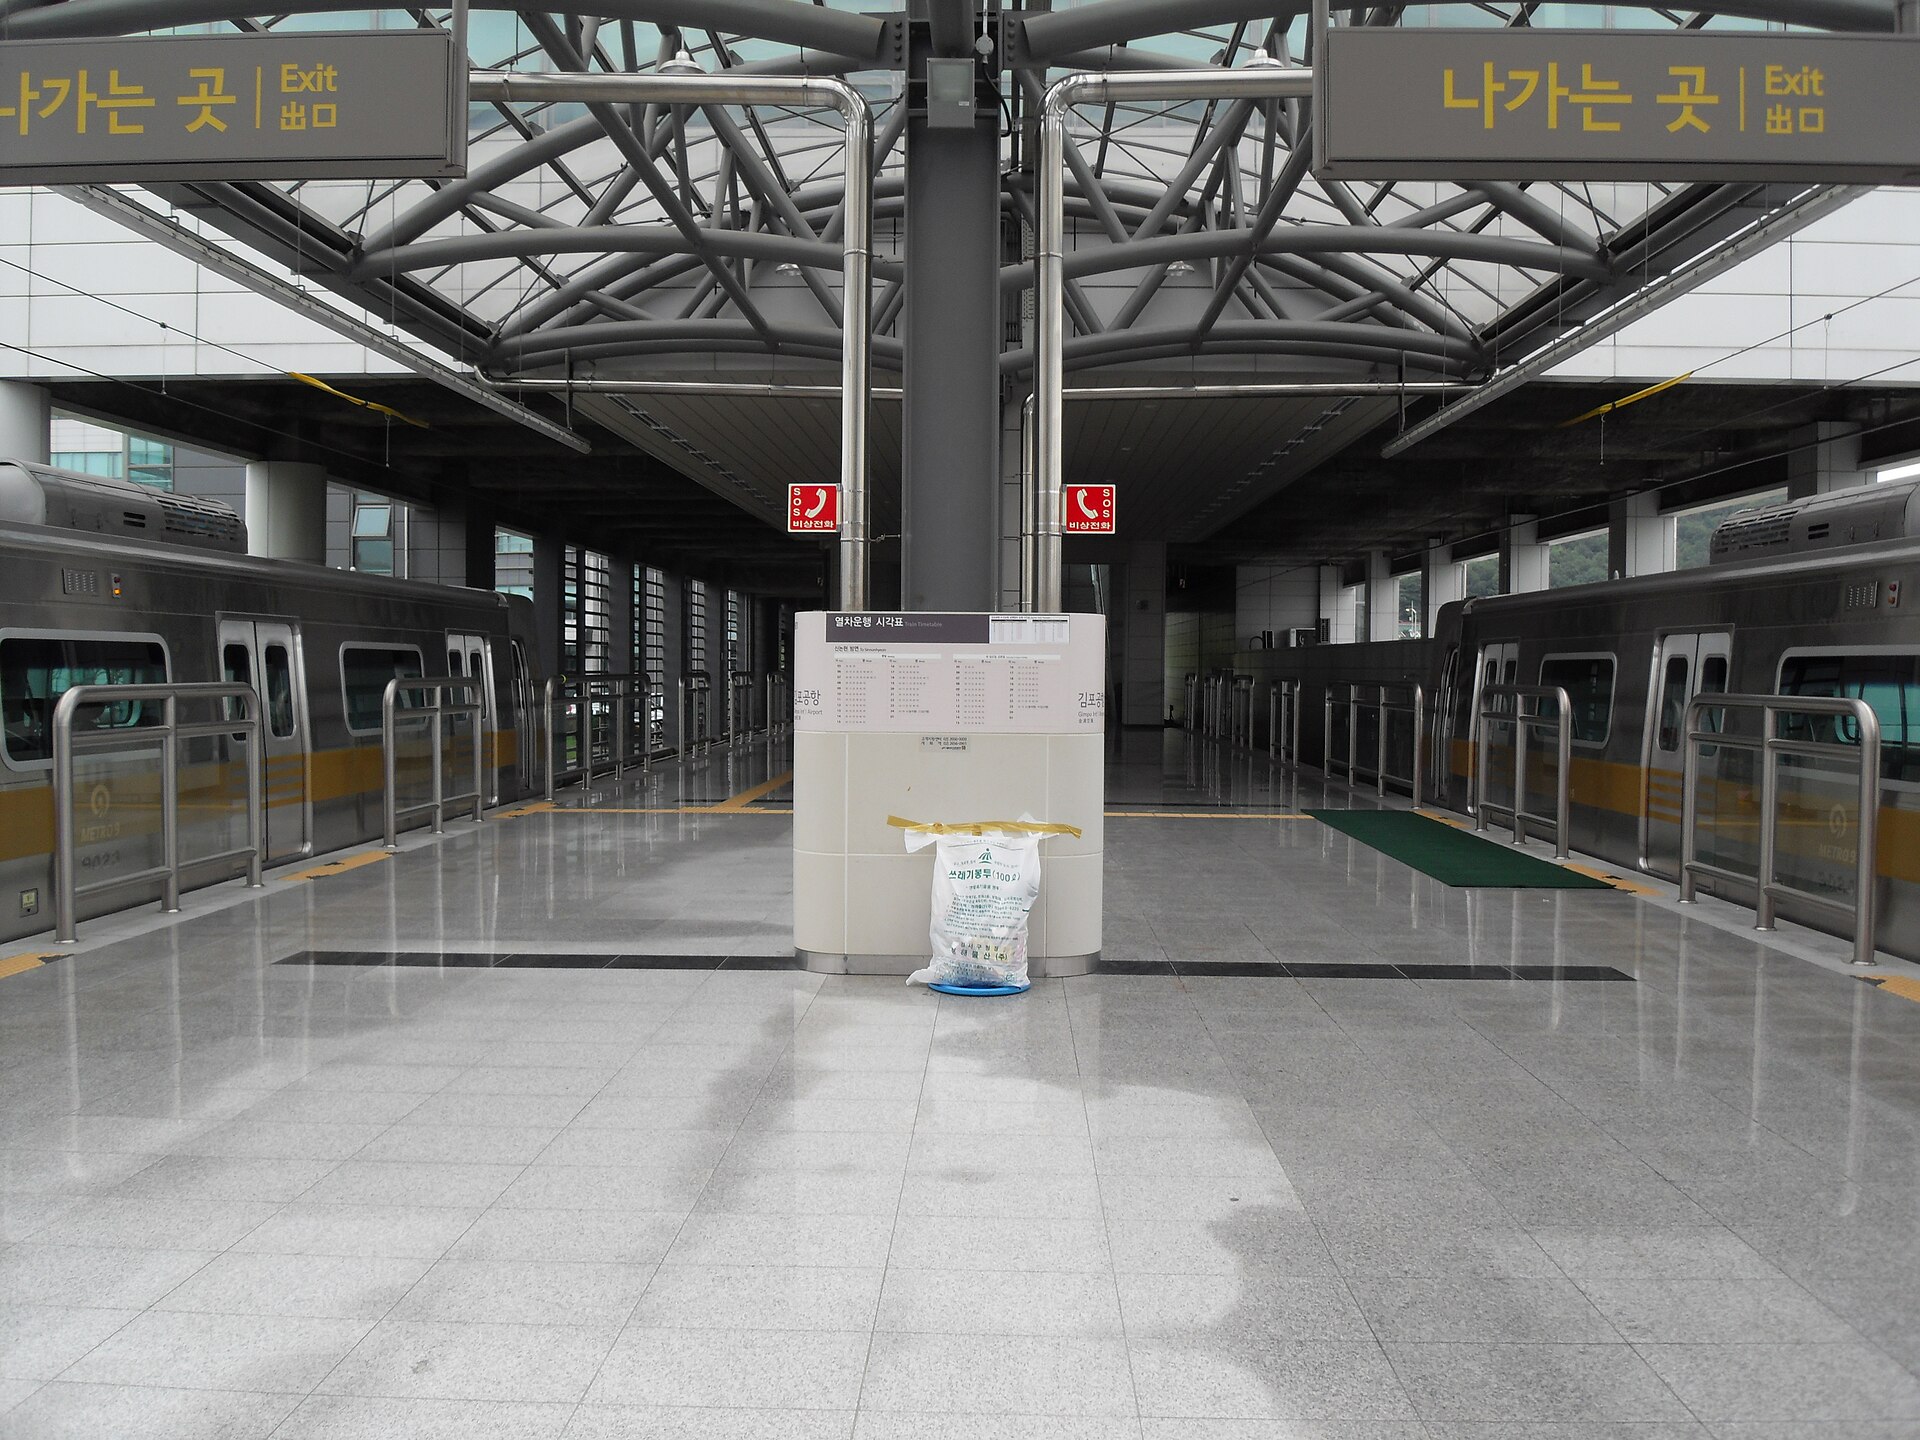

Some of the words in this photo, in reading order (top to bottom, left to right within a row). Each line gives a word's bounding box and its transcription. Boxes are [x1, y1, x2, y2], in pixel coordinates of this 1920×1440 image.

[281, 63, 338, 93] Exit
[1765, 65, 1824, 96] Exit
[177, 68, 236, 133] 곳
[1443, 62, 1632, 132] 나가는
[1656, 66, 1719, 133] 곳
[280, 102, 337, 131] 出口
[1765, 104, 1824, 134] 出口
[793, 487, 802, 517] SOS
[1102, 488, 1111, 518] SOS
[792, 520, 834, 529] 비상전화
[1069, 521, 1111, 530] 비상전화
[834, 616, 872, 628] 열차운행
[876, 616, 904, 628] 시각표
